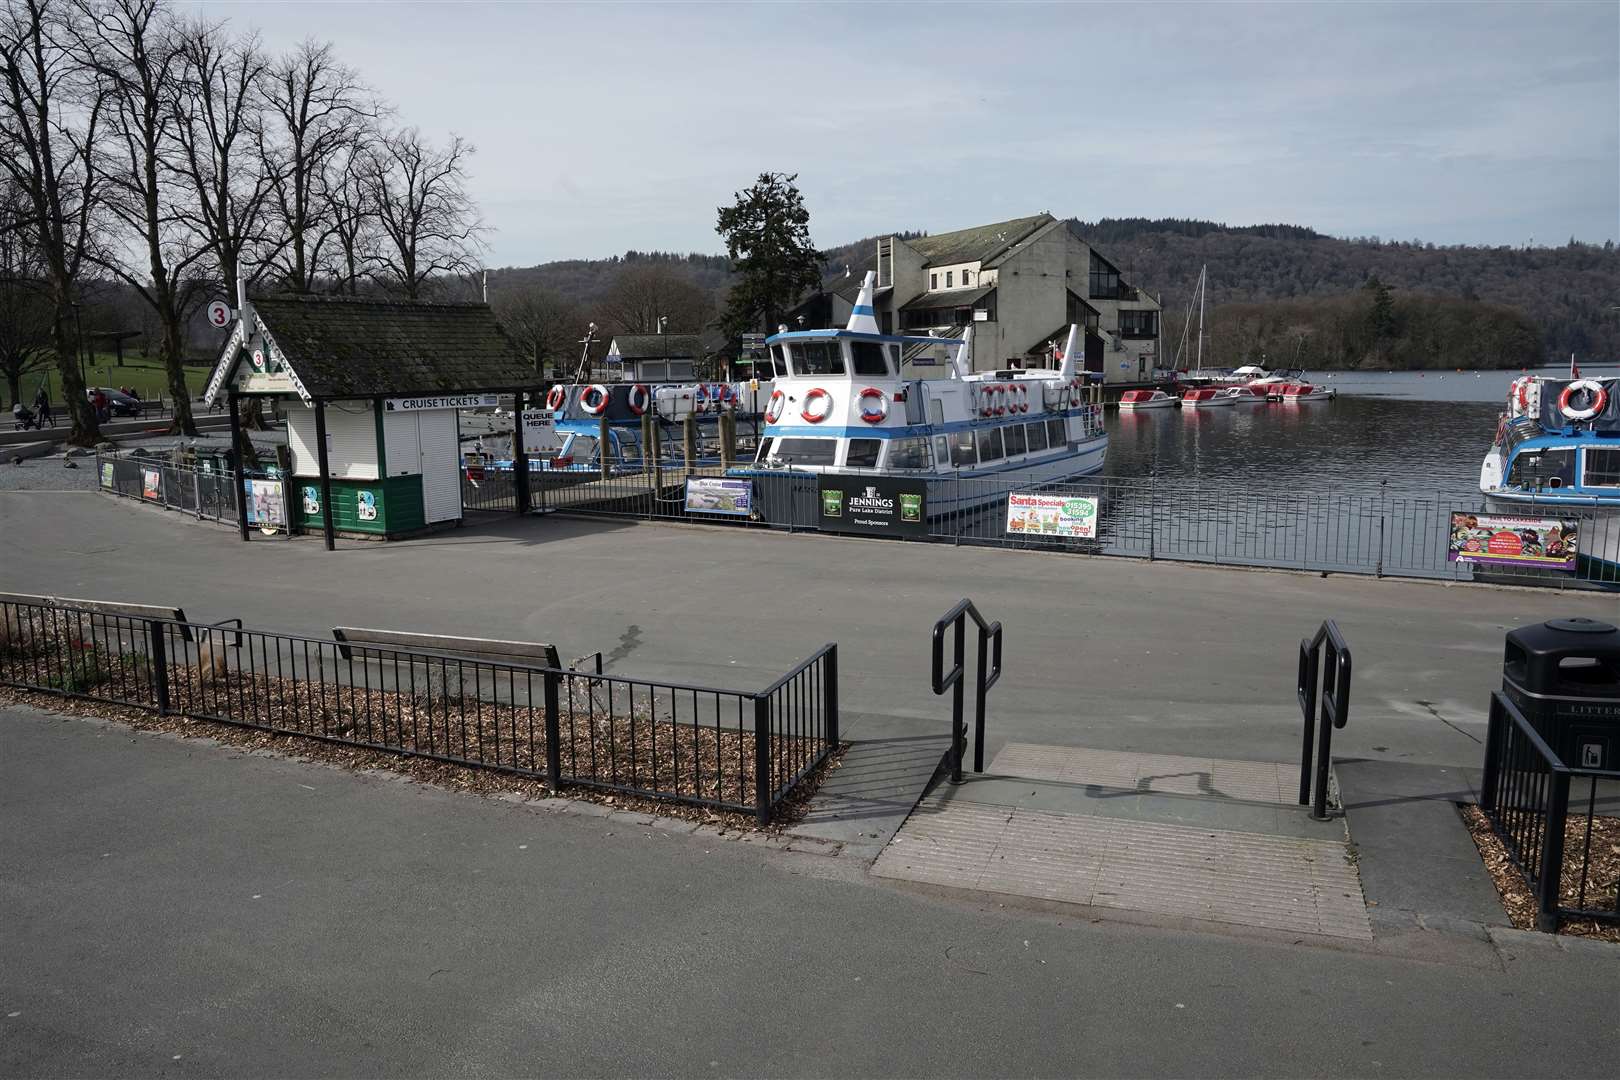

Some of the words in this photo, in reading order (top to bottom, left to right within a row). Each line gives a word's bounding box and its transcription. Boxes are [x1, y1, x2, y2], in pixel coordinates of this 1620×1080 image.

[213, 307, 226, 325] 3
[255, 353, 262, 365] 3
[402, 398, 439, 409] CRUISE
[439, 396, 480, 407] TICKETS
[522, 412, 554, 420] QUEUE
[848, 497, 894, 508] JENNINGS
[1010, 496, 1037, 505] Santa
[1037, 499, 1066, 507] Specials
[1071, 524, 1091, 533] open!
